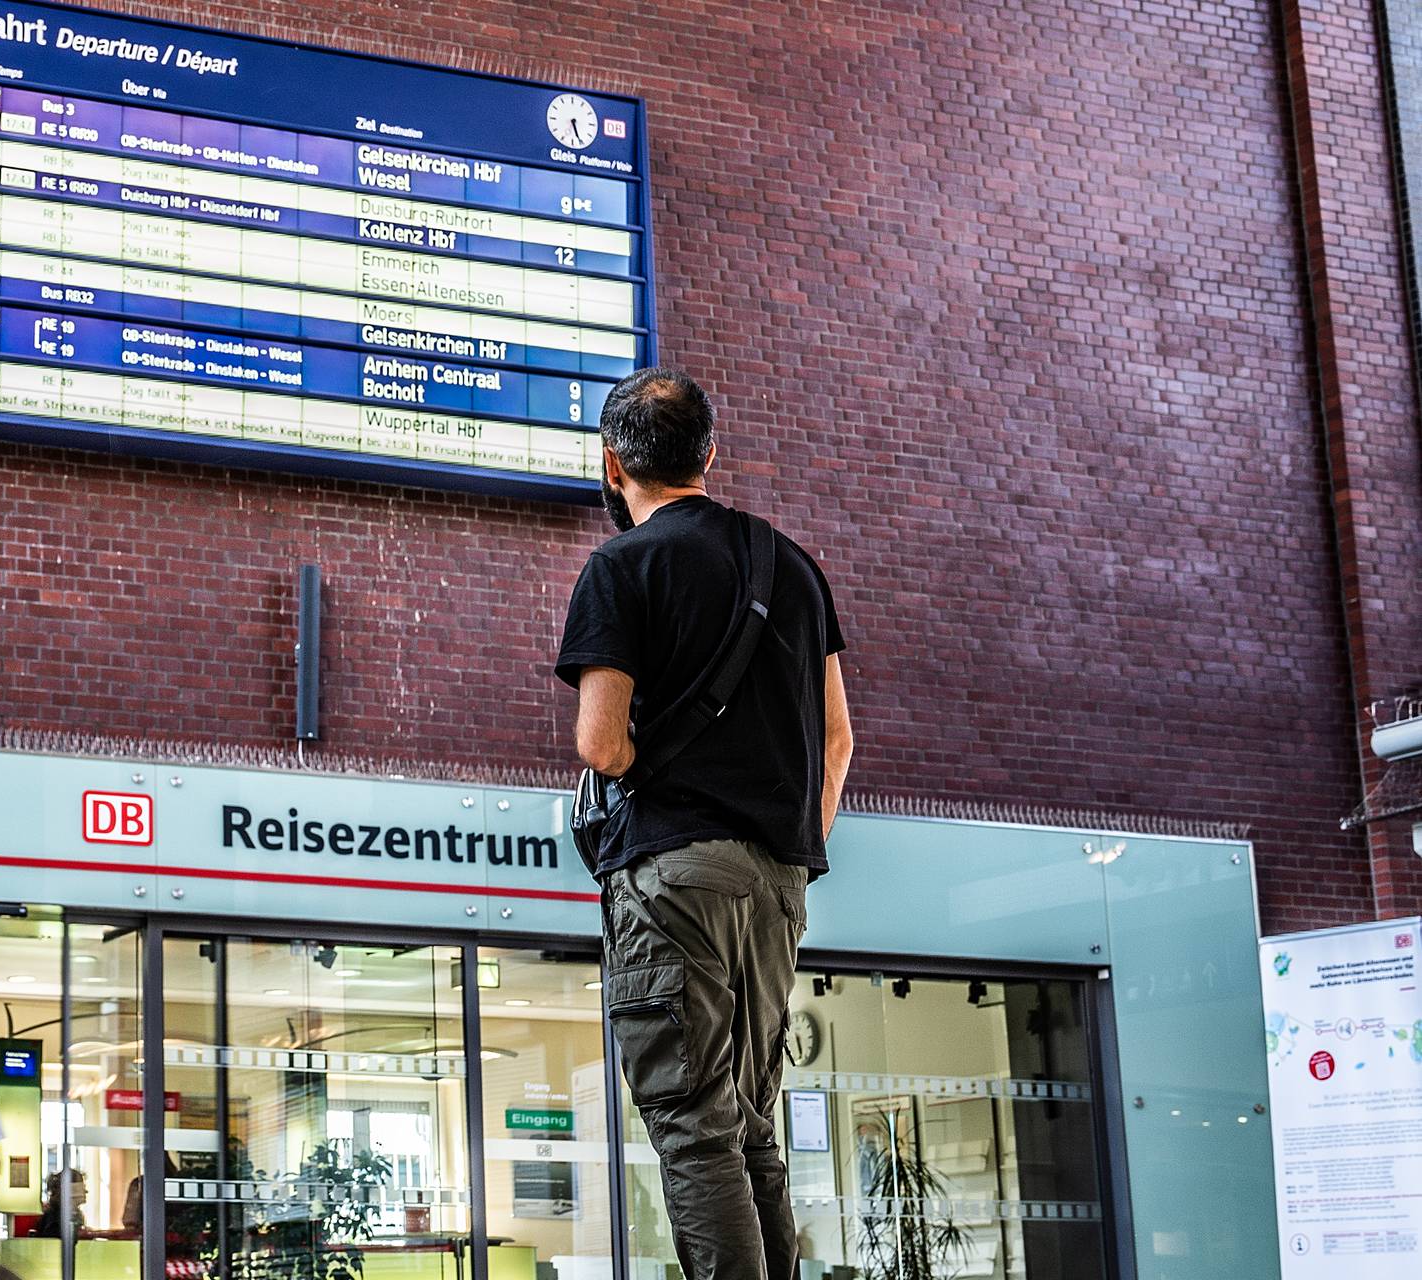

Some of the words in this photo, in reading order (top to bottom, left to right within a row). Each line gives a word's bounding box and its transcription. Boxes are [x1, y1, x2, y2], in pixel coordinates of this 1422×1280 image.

[56, 27, 159, 63] Departure
[161, 45, 174, 65] /
[176, 48, 238, 76] Départ
[122, 79, 149, 97] Über
[42, 99, 64, 115] Bus
[65, 103, 75, 116] 3
[41, 122, 57, 136] RE
[58, 125, 68, 138] 5
[355, 116, 376, 131] Ziel
[379, 123, 423, 139] Destination
[605, 121, 624, 136] DB
[267, 156, 320, 175] Dinslaken
[358, 145, 470, 179] Gelsenkirchen
[473, 162, 502, 183] Hbf
[550, 148, 577, 163] Gleis
[41, 176, 57, 191] RE
[58, 179, 68, 192] 5
[358, 167, 411, 192] Wesel
[121, 187, 169, 208] Duisburg
[170, 195, 190, 209] Hbf
[200, 199, 259, 219] Düsseldorf
[260, 208, 280, 222] Hbf
[361, 198, 494, 232] Duisburg-Ruhrort
[560, 196, 573, 215] 9
[359, 219, 424, 246] Koblenz
[428, 229, 457, 250] Hbf
[362, 250, 440, 275] Emmerich
[554, 247, 575, 266] 12
[41, 286, 64, 301] Bus
[65, 288, 95, 305] RB32
[362, 273, 504, 307] Essen-Altenessen
[363, 303, 413, 324] Moers
[41, 317, 58, 332] RE
[60, 321, 75, 334] 19
[41, 340, 57, 355] RE
[60, 344, 75, 358] 19
[122, 328, 196, 350] OB-Sterkrade
[205, 338, 259, 358] Dinslaken
[268, 347, 303, 363] Wesel
[361, 325, 475, 357] Gelsenkirchen
[479, 340, 507, 361] Hbf
[121, 350, 196, 373] OB-Sterkrade
[205, 361, 259, 381] Dinslaken
[268, 369, 303, 386] Wesel
[363, 356, 429, 382] Arnhem
[432, 364, 502, 391] Centraal
[362, 377, 425, 403] Bocholt
[569, 381, 582, 400] 9
[569, 403, 582, 422] 9
[366, 410, 450, 435] Wuppertal
[457, 421, 483, 439] Hbf
[89, 796, 147, 840] DB
[222, 805, 559, 869] Reisezentrum
[511, 1113, 567, 1127] Eingang
